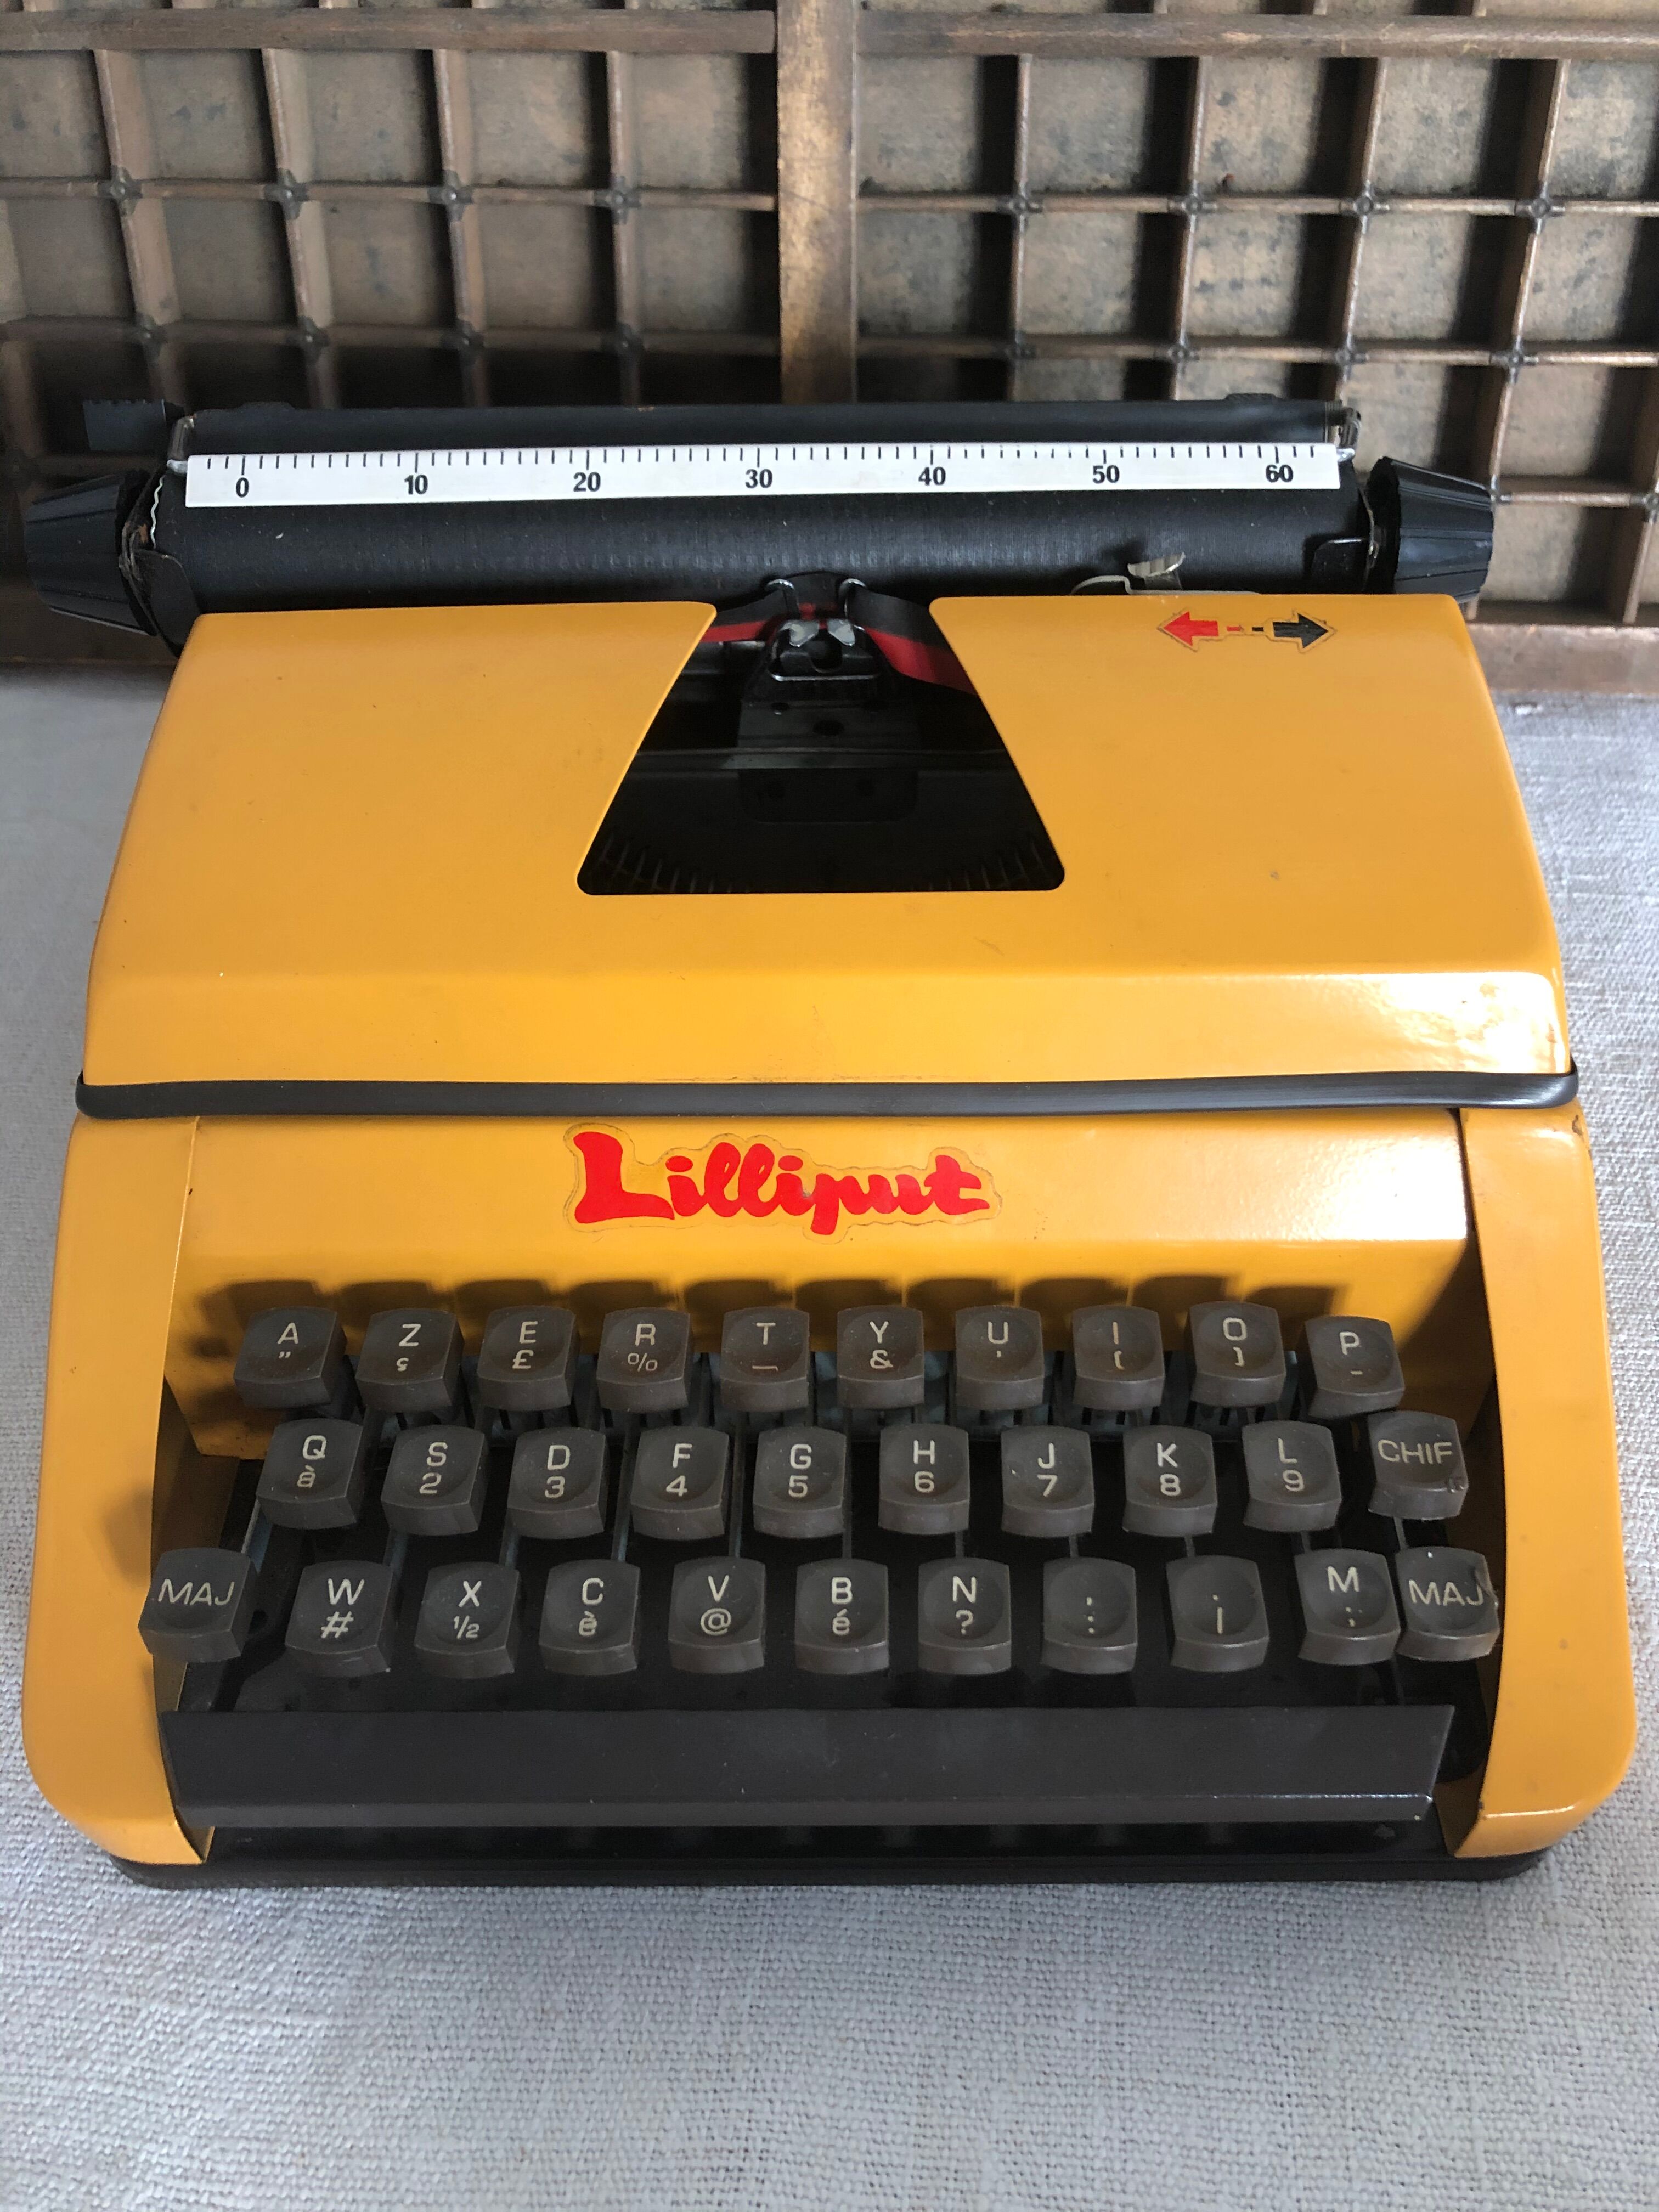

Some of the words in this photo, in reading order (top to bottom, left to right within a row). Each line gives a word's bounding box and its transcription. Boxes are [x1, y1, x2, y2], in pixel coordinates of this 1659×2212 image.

[236, 477, 249, 497] 0
[405, 475, 427, 494] 10
[574, 472, 600, 492] 20
[746, 469, 772, 488] 30
[919, 467, 945, 485] 40
[1093, 465, 1120, 484] 50
[1266, 464, 1294, 483] 60
[573, 1131, 990, 1235] Lilliput
[278, 1323, 298, 1344] A
[399, 1324, 421, 1346] Z
[520, 1321, 538, 1343] E
[635, 1324, 656, 1346] R
[757, 1323, 775, 1345] T
[870, 1322, 888, 1343] Y
[988, 1322, 1008, 1344] U
[1113, 1322, 1118, 1344] I
[1223, 1318, 1246, 1340] O
[1340, 1332, 1359, 1355] P
[512, 1350, 533, 1369] £
[628, 1353, 657, 1371] %
[870, 1350, 893, 1369] &
[303, 1436, 326, 1459] Q
[427, 1442, 448, 1466] S
[548, 1445, 570, 1470] D
[673, 1444, 692, 1468] F
[791, 1444, 811, 1469] G
[914, 1441, 935, 1464] H
[1038, 1443, 1054, 1468] J
[1158, 1443, 1177, 1467] K
[1278, 1438, 1297, 1463] L
[1378, 1439, 1453, 1464] CHIF
[297, 1465, 315, 1487] à
[420, 1473, 441, 1493] 2
[545, 1476, 565, 1498] 3
[666, 1476, 687, 1496] 4
[789, 1475, 808, 1497] 5
[915, 1471, 934, 1492] 6
[1037, 1475, 1057, 1496] 7
[1160, 1474, 1180, 1496] 8
[1283, 1470, 1304, 1491] 9
[708, 1576, 729, 1601] V
[832, 1577, 852, 1604] B
[953, 1576, 976, 1602] N
[1328, 1566, 1358, 1592] M
[159, 1579, 234, 1605] MAJ
[328, 1579, 364, 1605] W
[459, 1581, 481, 1607] X
[583, 1578, 603, 1604] C
[1409, 1580, 1482, 1605] MAJ
[321, 1612, 353, 1638] #
[579, 1611, 597, 1635] è
[701, 1609, 731, 1634] @
[833, 1609, 850, 1634] é
[956, 1610, 973, 1633] ?
